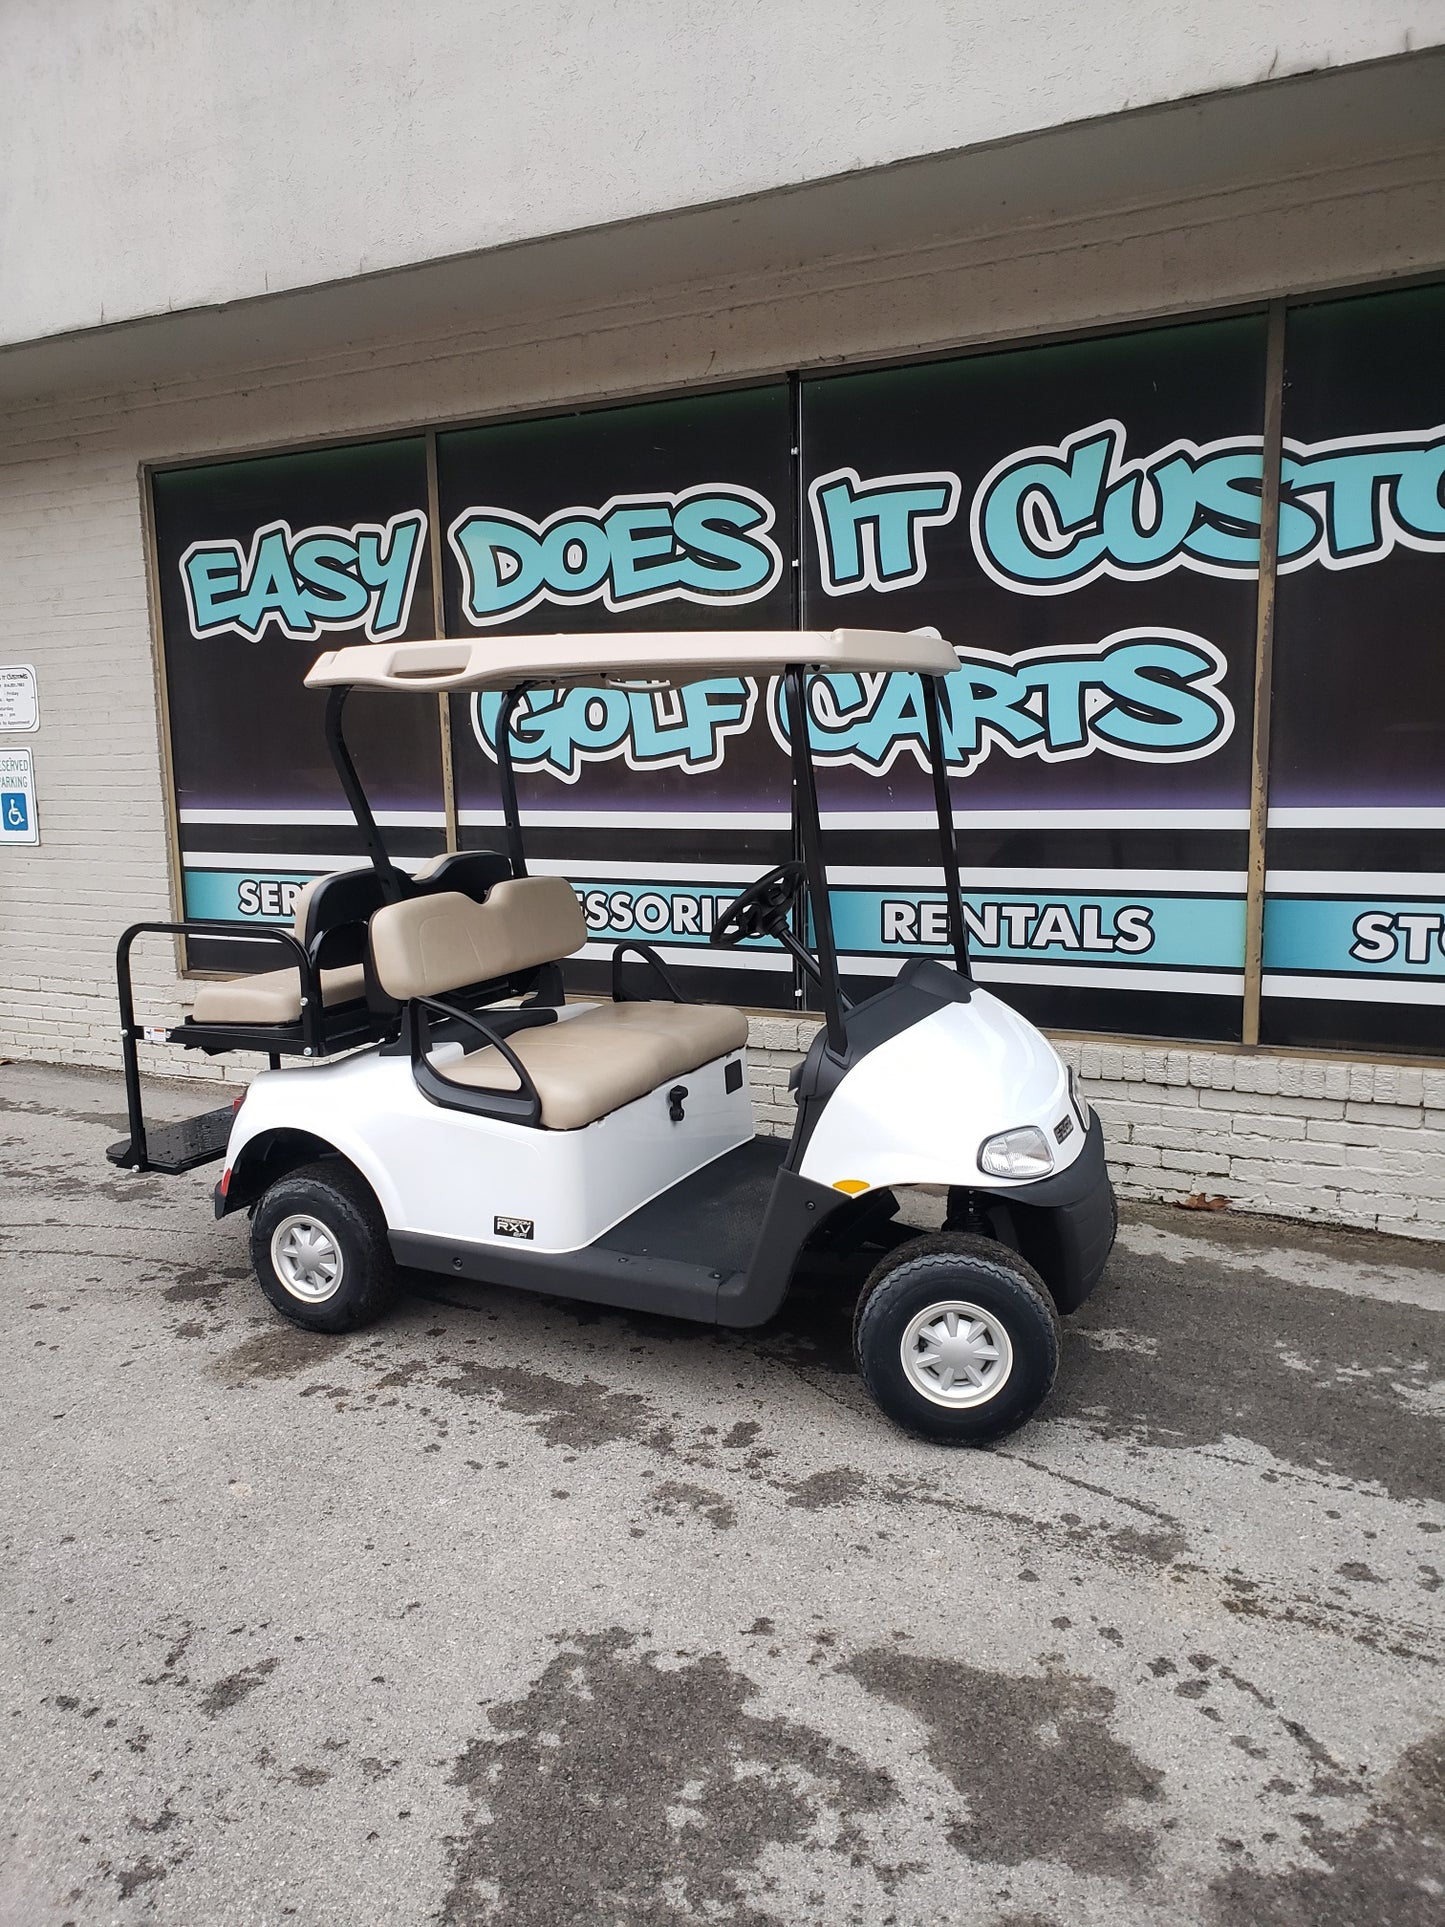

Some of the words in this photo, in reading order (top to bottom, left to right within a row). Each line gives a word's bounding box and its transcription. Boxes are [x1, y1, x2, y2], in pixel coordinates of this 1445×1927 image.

[179, 508, 428, 643] EASY
[448, 483, 784, 627] DOES
[808, 467, 962, 597] IT
[471, 675, 759, 785] GOLF
[766, 627, 1236, 778] CARTS
[0, 759, 28, 772] SERVED
[0, 776, 28, 788] ARKING
[238, 879, 310, 917] SER
[881, 900, 1155, 954] RENTALS
[1348, 910, 1445, 964] ST
[497, 1221, 531, 1234] RXV
